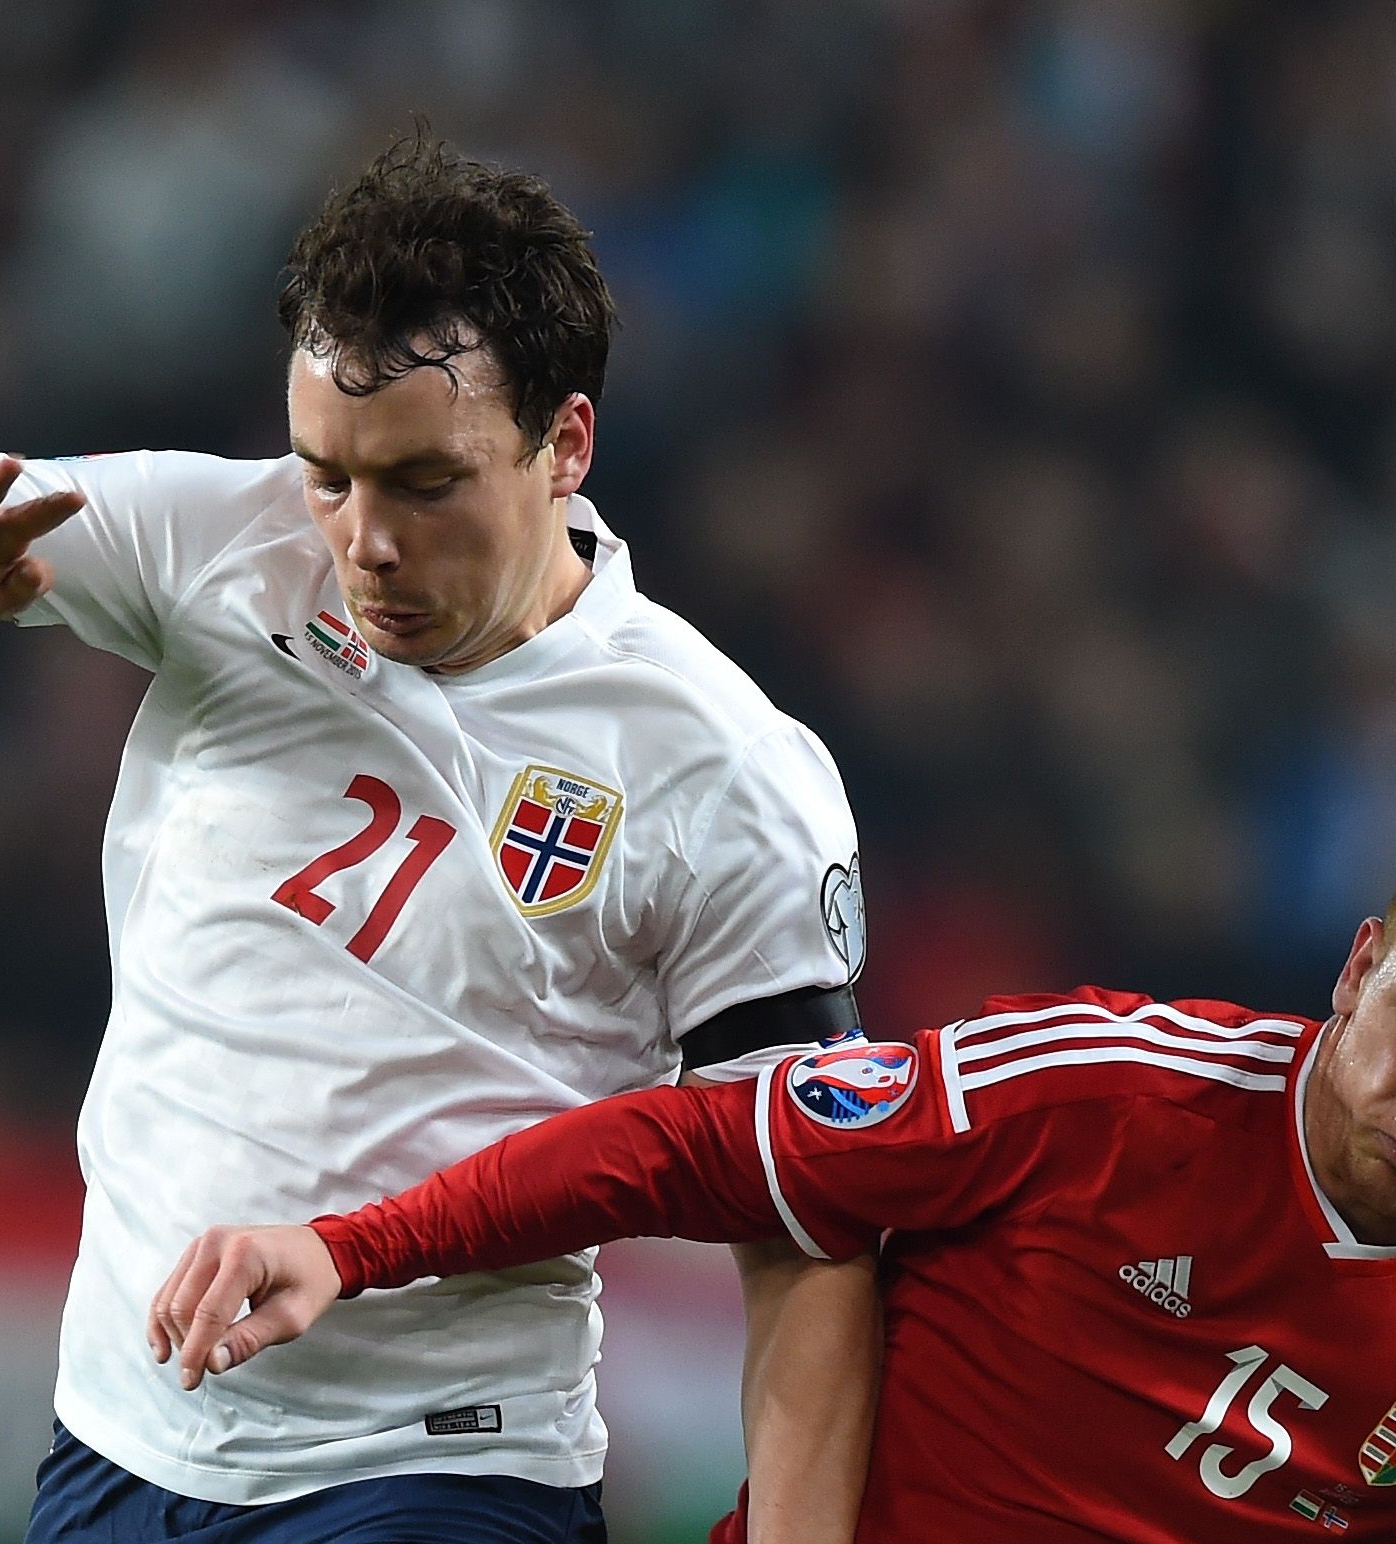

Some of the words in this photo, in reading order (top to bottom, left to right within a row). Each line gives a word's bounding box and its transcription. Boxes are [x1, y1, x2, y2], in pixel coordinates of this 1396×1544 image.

[304, 631, 313, 642] 15
[310, 639, 350, 672] NOVEMBER
[556, 778, 591, 799] NORGE
[270, 774, 458, 965] 21
[1118, 1264, 1192, 1318] adidas
[1164, 1344, 1330, 1499] 15
